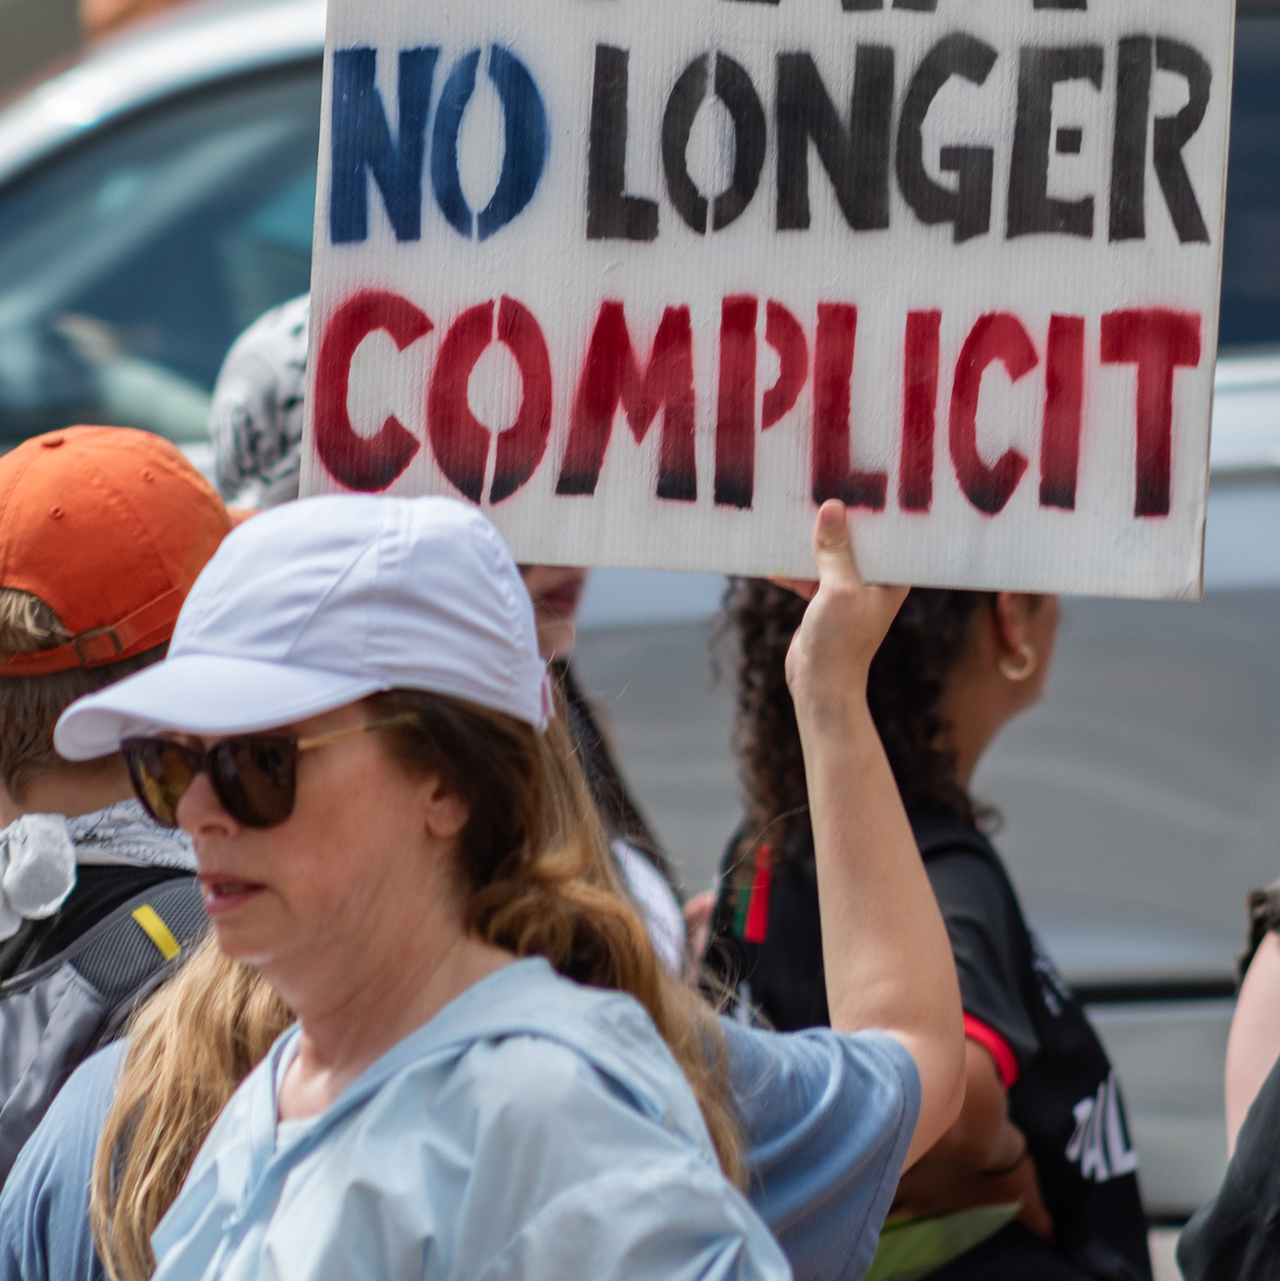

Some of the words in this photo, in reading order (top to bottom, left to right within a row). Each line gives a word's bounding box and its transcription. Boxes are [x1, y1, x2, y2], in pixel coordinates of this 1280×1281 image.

[329, 43, 551, 243] NO
[586, 32, 1212, 244] LONGER
[316, 288, 1202, 518] COMPLICIT
